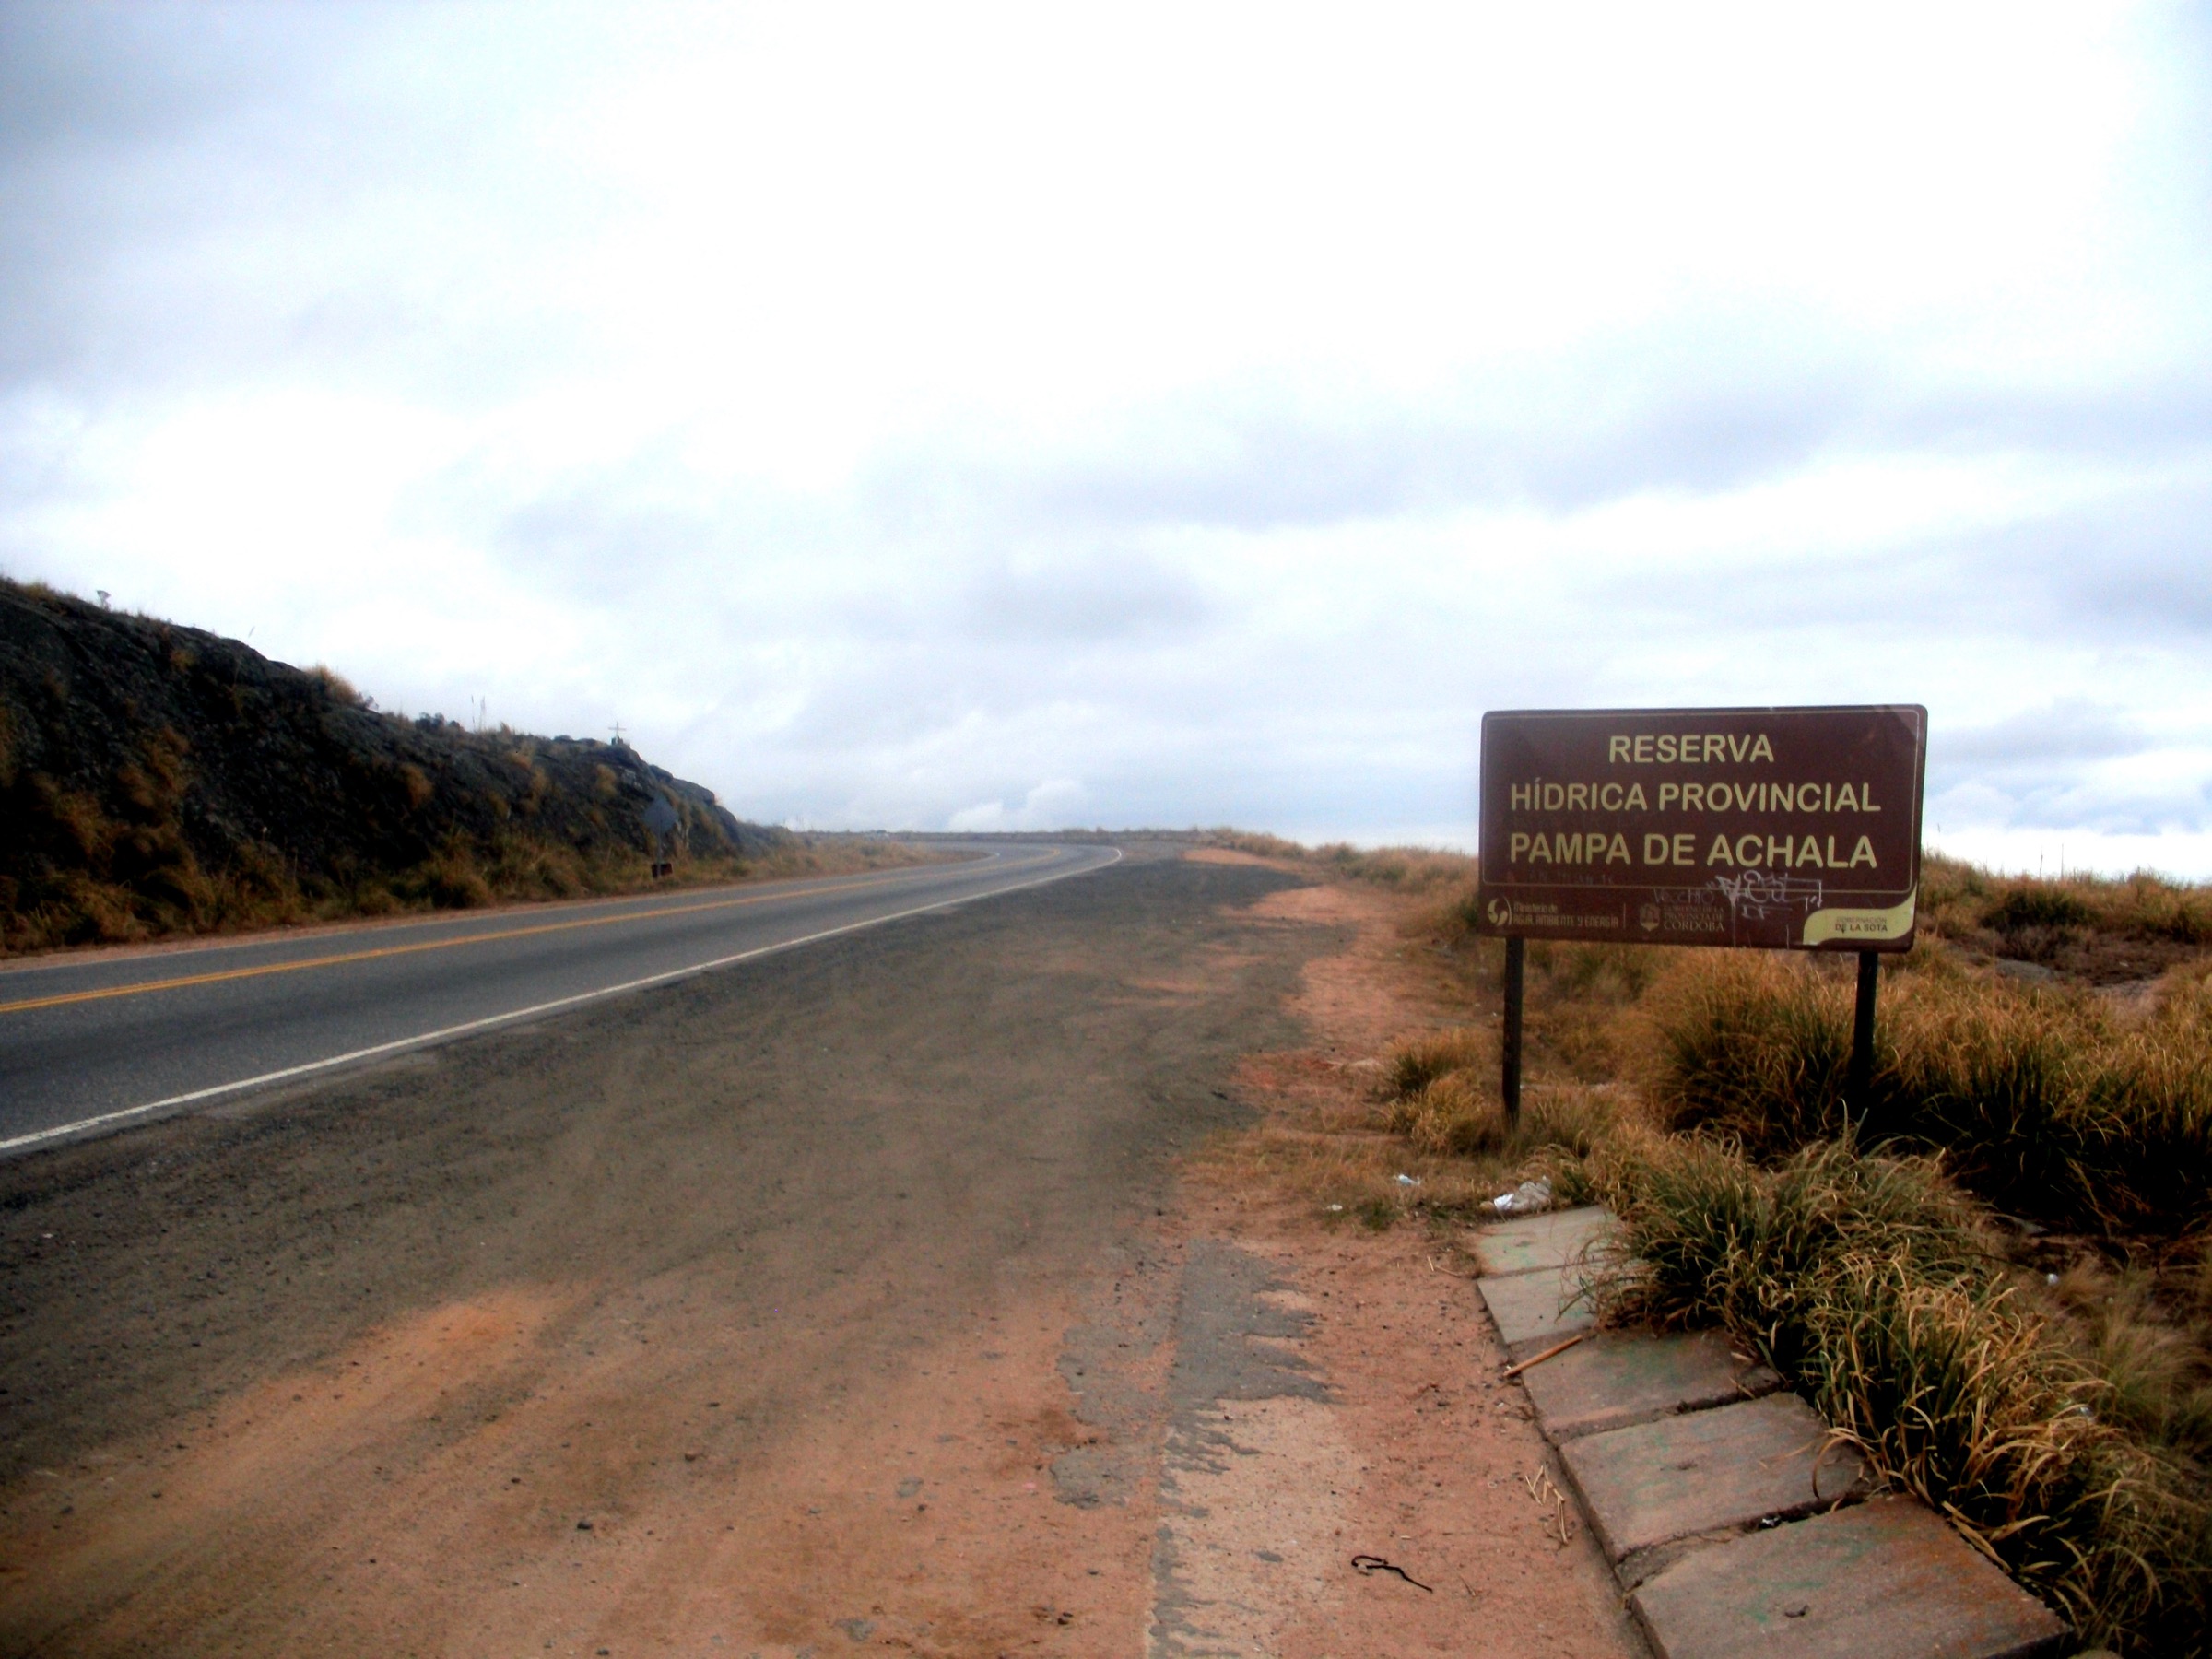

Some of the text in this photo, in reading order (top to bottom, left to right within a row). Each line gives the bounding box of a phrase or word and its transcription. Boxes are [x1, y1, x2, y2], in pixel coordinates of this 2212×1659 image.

[1609, 734, 1774, 763] RESERVA
[1512, 777, 1881, 813] HÍDRICA PROVINCIAL
[1511, 832, 1877, 868] PAMPA DE ACHALA
[1835, 923, 1888, 932] DE LA SOTA
